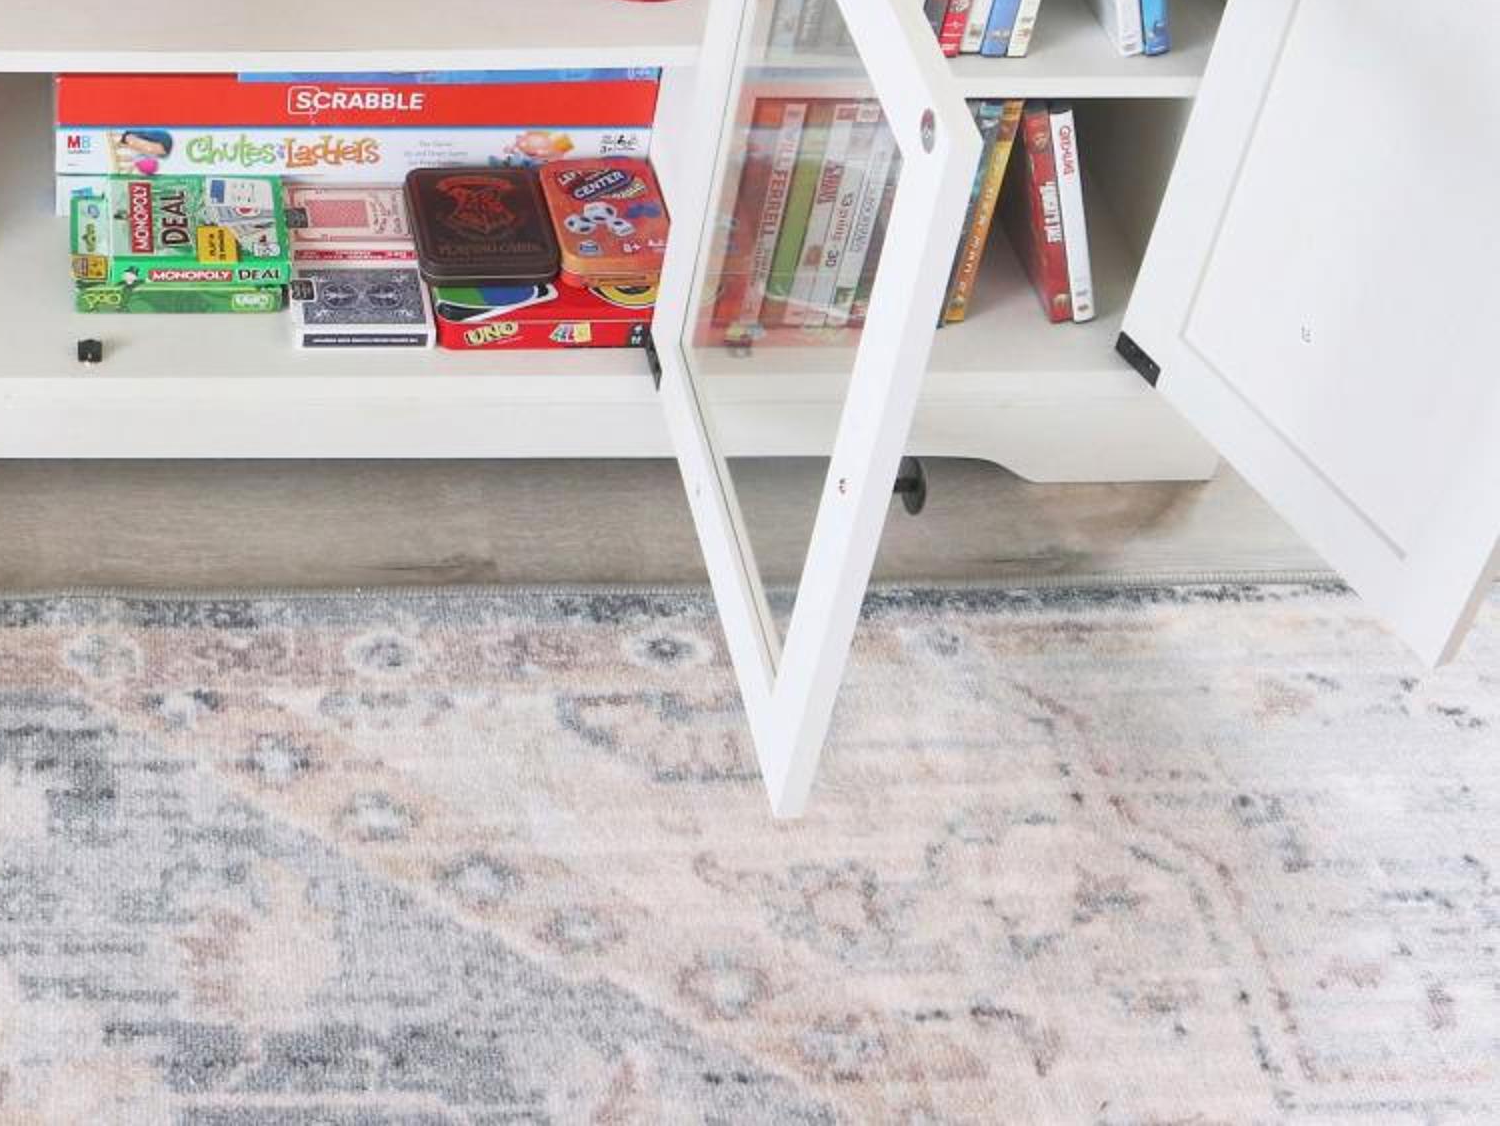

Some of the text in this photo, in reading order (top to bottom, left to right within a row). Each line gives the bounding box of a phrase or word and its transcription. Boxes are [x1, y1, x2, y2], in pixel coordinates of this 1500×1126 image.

[295, 91, 425, 110] SCRABBLE
[67, 135, 91, 149] MB
[185, 134, 277, 167] Chutes
[283, 135, 382, 168] Ladders
[574, 171, 626, 201] CENTER
[132, 184, 150, 251] MONOPOLY
[160, 189, 191, 247] DEAL
[150, 270, 231, 281] MONOPOLY
[463, 322, 519, 345] UNO
